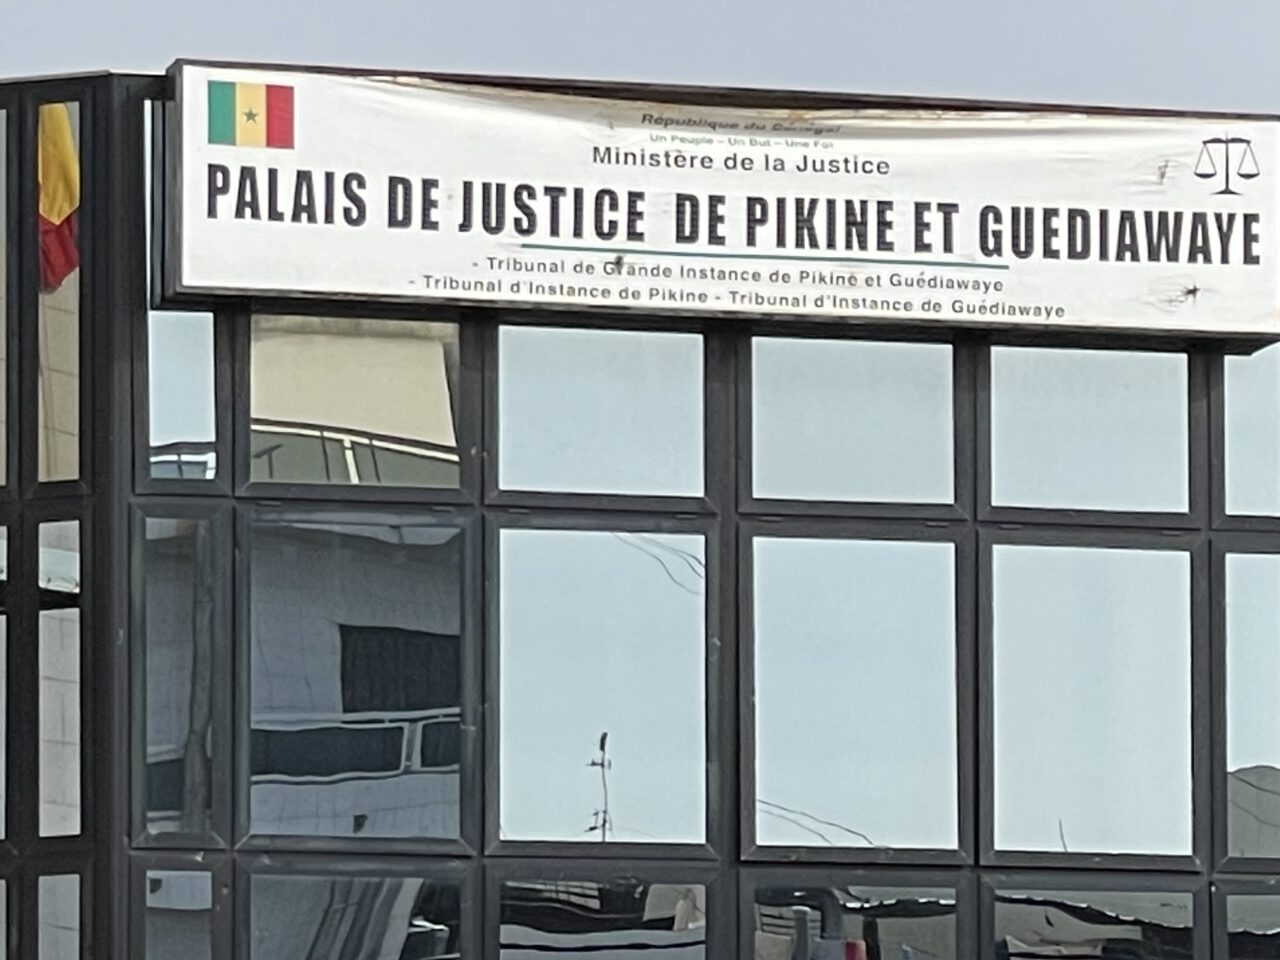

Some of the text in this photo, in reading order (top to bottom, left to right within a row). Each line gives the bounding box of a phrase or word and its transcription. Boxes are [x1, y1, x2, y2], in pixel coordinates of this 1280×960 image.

[592, 146, 891, 175] Ministère de la Justice
[206, 162, 1262, 266] PALAIS DE JUSTICE DE PIKINE ET GUEDIAWAYE
[486, 256, 566, 273] Tribunal
[573, 260, 595, 274] de
[603, 260, 673, 278] Grande
[680, 265, 761, 282] Instance
[769, 270, 791, 284] de
[799, 270, 858, 287] Pikine
[864, 274, 882, 287] et
[889, 272, 1004, 294] Guédiawaye
[423, 274, 502, 292] Tribunal
[510, 279, 612, 298] d'Instance
[619, 286, 641, 300] de
[649, 287, 708, 304] Pikine
[729, 290, 807, 308] Tribunal
[814, 295, 914, 313] d'Instance
[921, 299, 943, 313] de
[951, 299, 1066, 321] Guédiawaye
